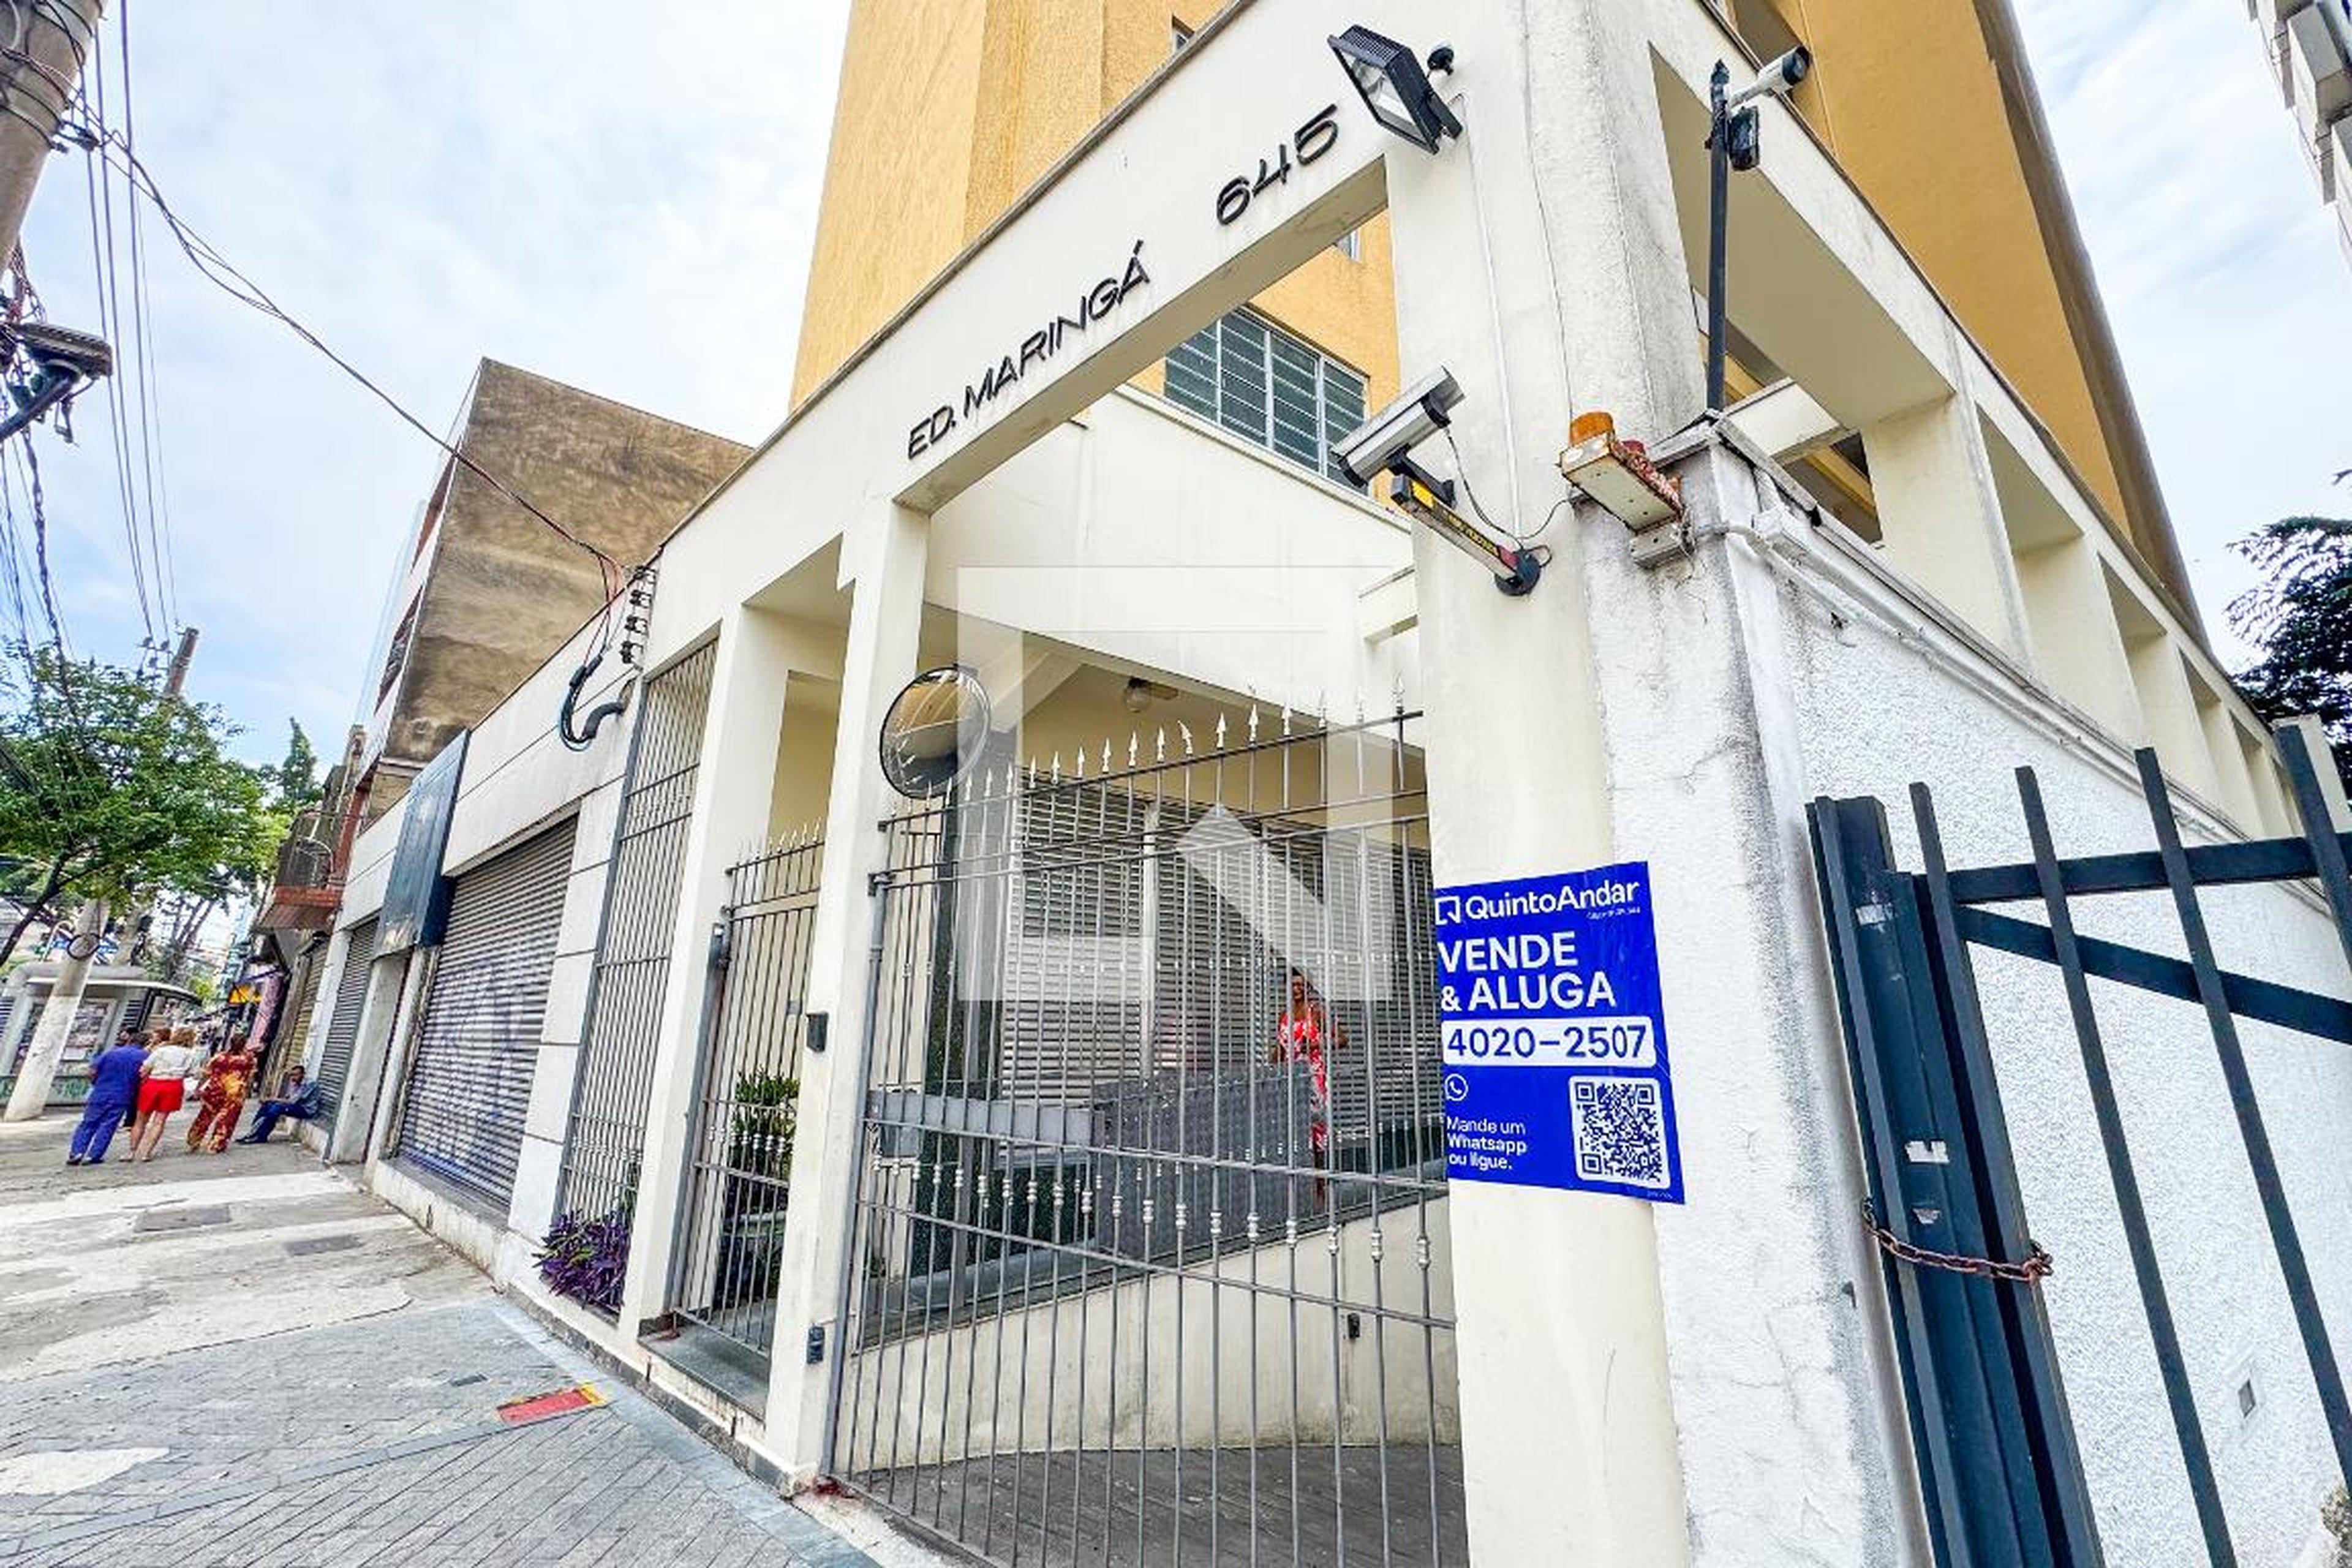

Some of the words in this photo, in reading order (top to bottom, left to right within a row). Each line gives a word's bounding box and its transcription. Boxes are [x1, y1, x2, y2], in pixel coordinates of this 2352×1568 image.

[1216, 103, 1339, 226] 645
[908, 406, 957, 460] ED.
[963, 239, 1150, 419] MARINGÁ
[1465, 880, 1640, 919] QuintoAndar
[1437, 931, 1578, 973] VENDE
[1441, 986, 1463, 1011] &
[1468, 970, 1618, 1011] ALUGA
[1447, 1025, 1646, 1058] 4020-2507
[1447, 1115, 1498, 1134] Mande
[1499, 1121, 1526, 1136] um
[1447, 1133, 1527, 1156] Whatsapp
[1449, 1153, 1467, 1166] ou
[1469, 1151, 1512, 1171] ligue.
